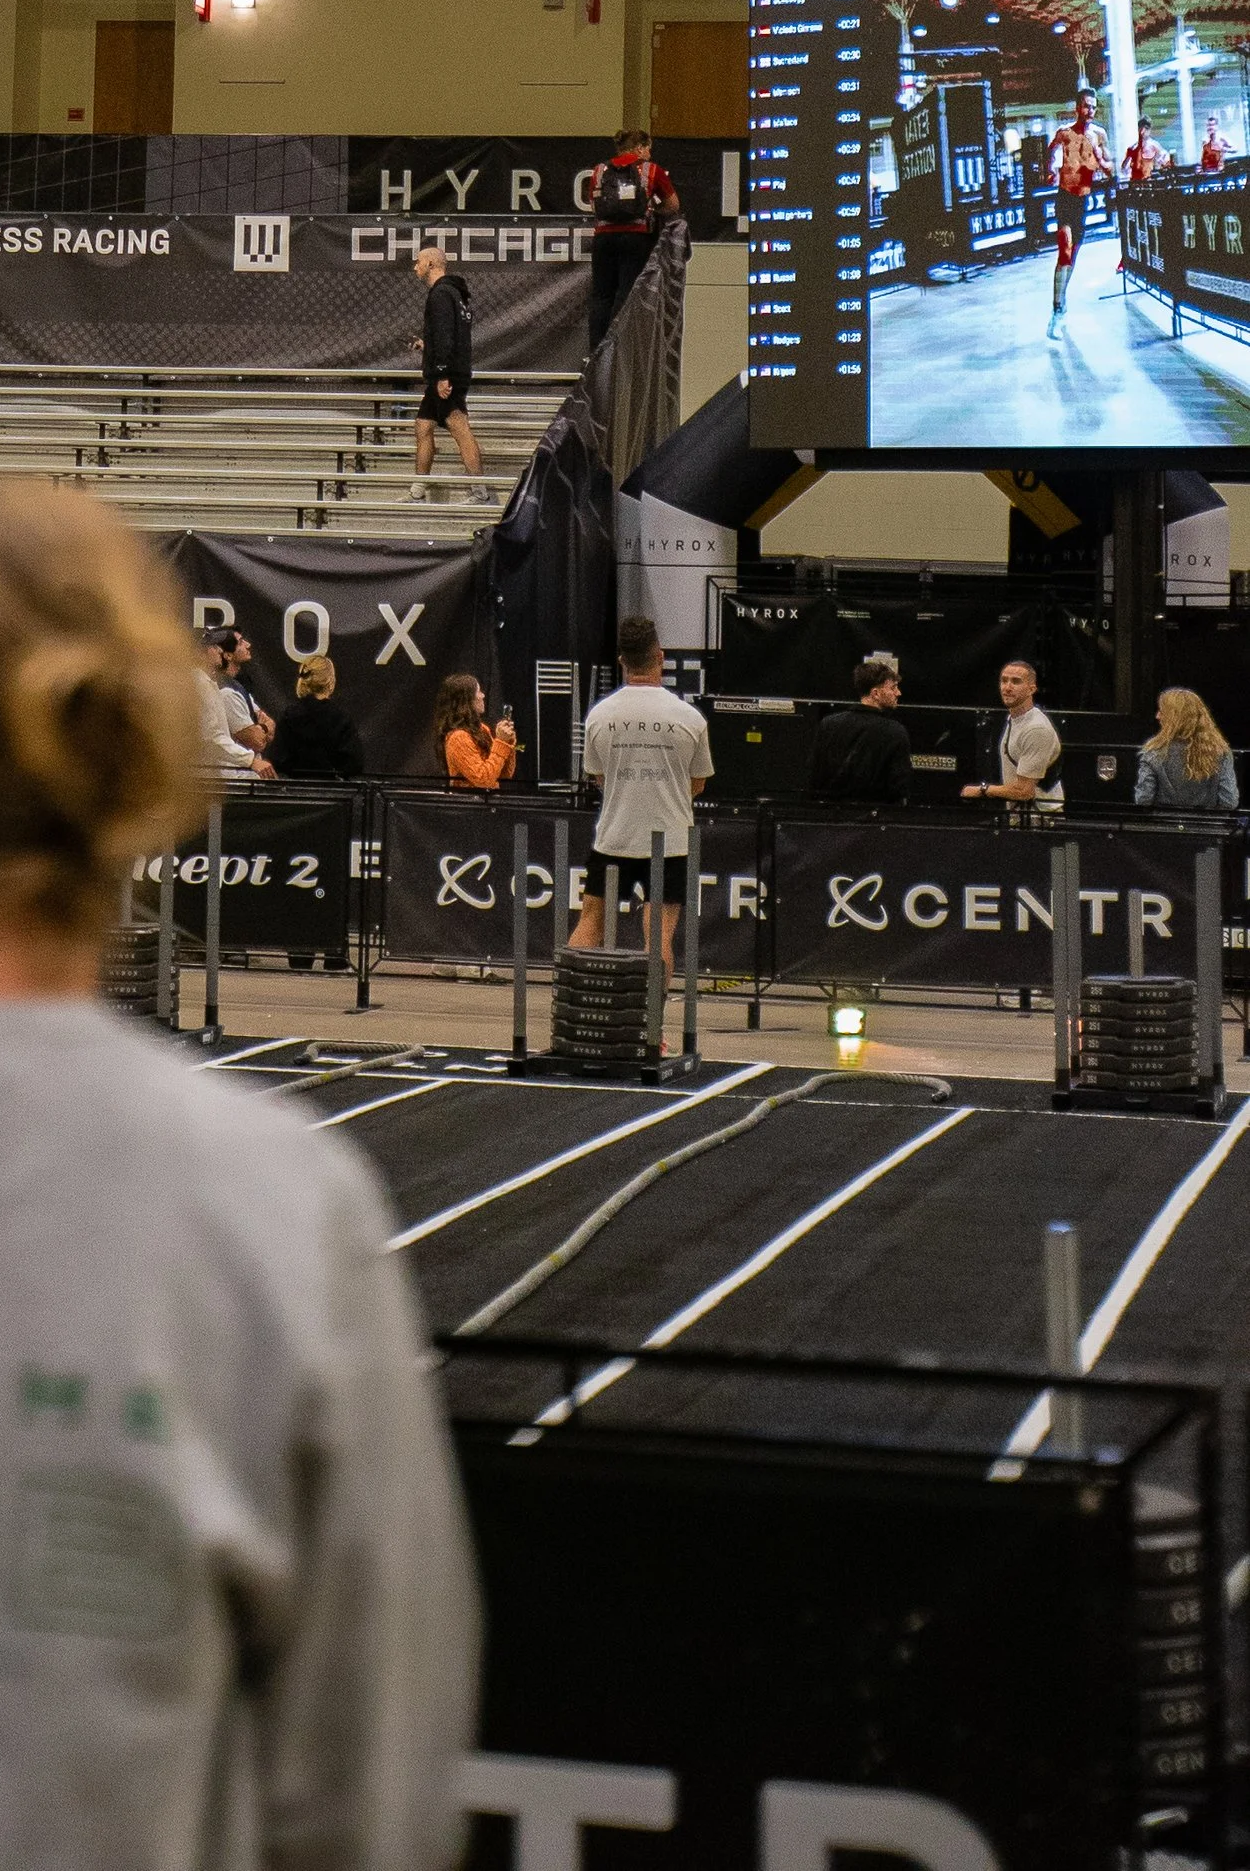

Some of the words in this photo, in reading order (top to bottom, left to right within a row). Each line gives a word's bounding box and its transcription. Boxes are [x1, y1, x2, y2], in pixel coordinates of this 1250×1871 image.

[381, 169, 593, 212] HYRO
[53, 228, 170, 255] RACING
[648, 539, 717, 552] HYROX
[1170, 553, 1213, 568] ROX
[737, 607, 798, 619] HYROX
[608, 721, 675, 733] HYROX
[286, 855, 320, 888] 2
[904, 883, 1174, 938] CENTR
